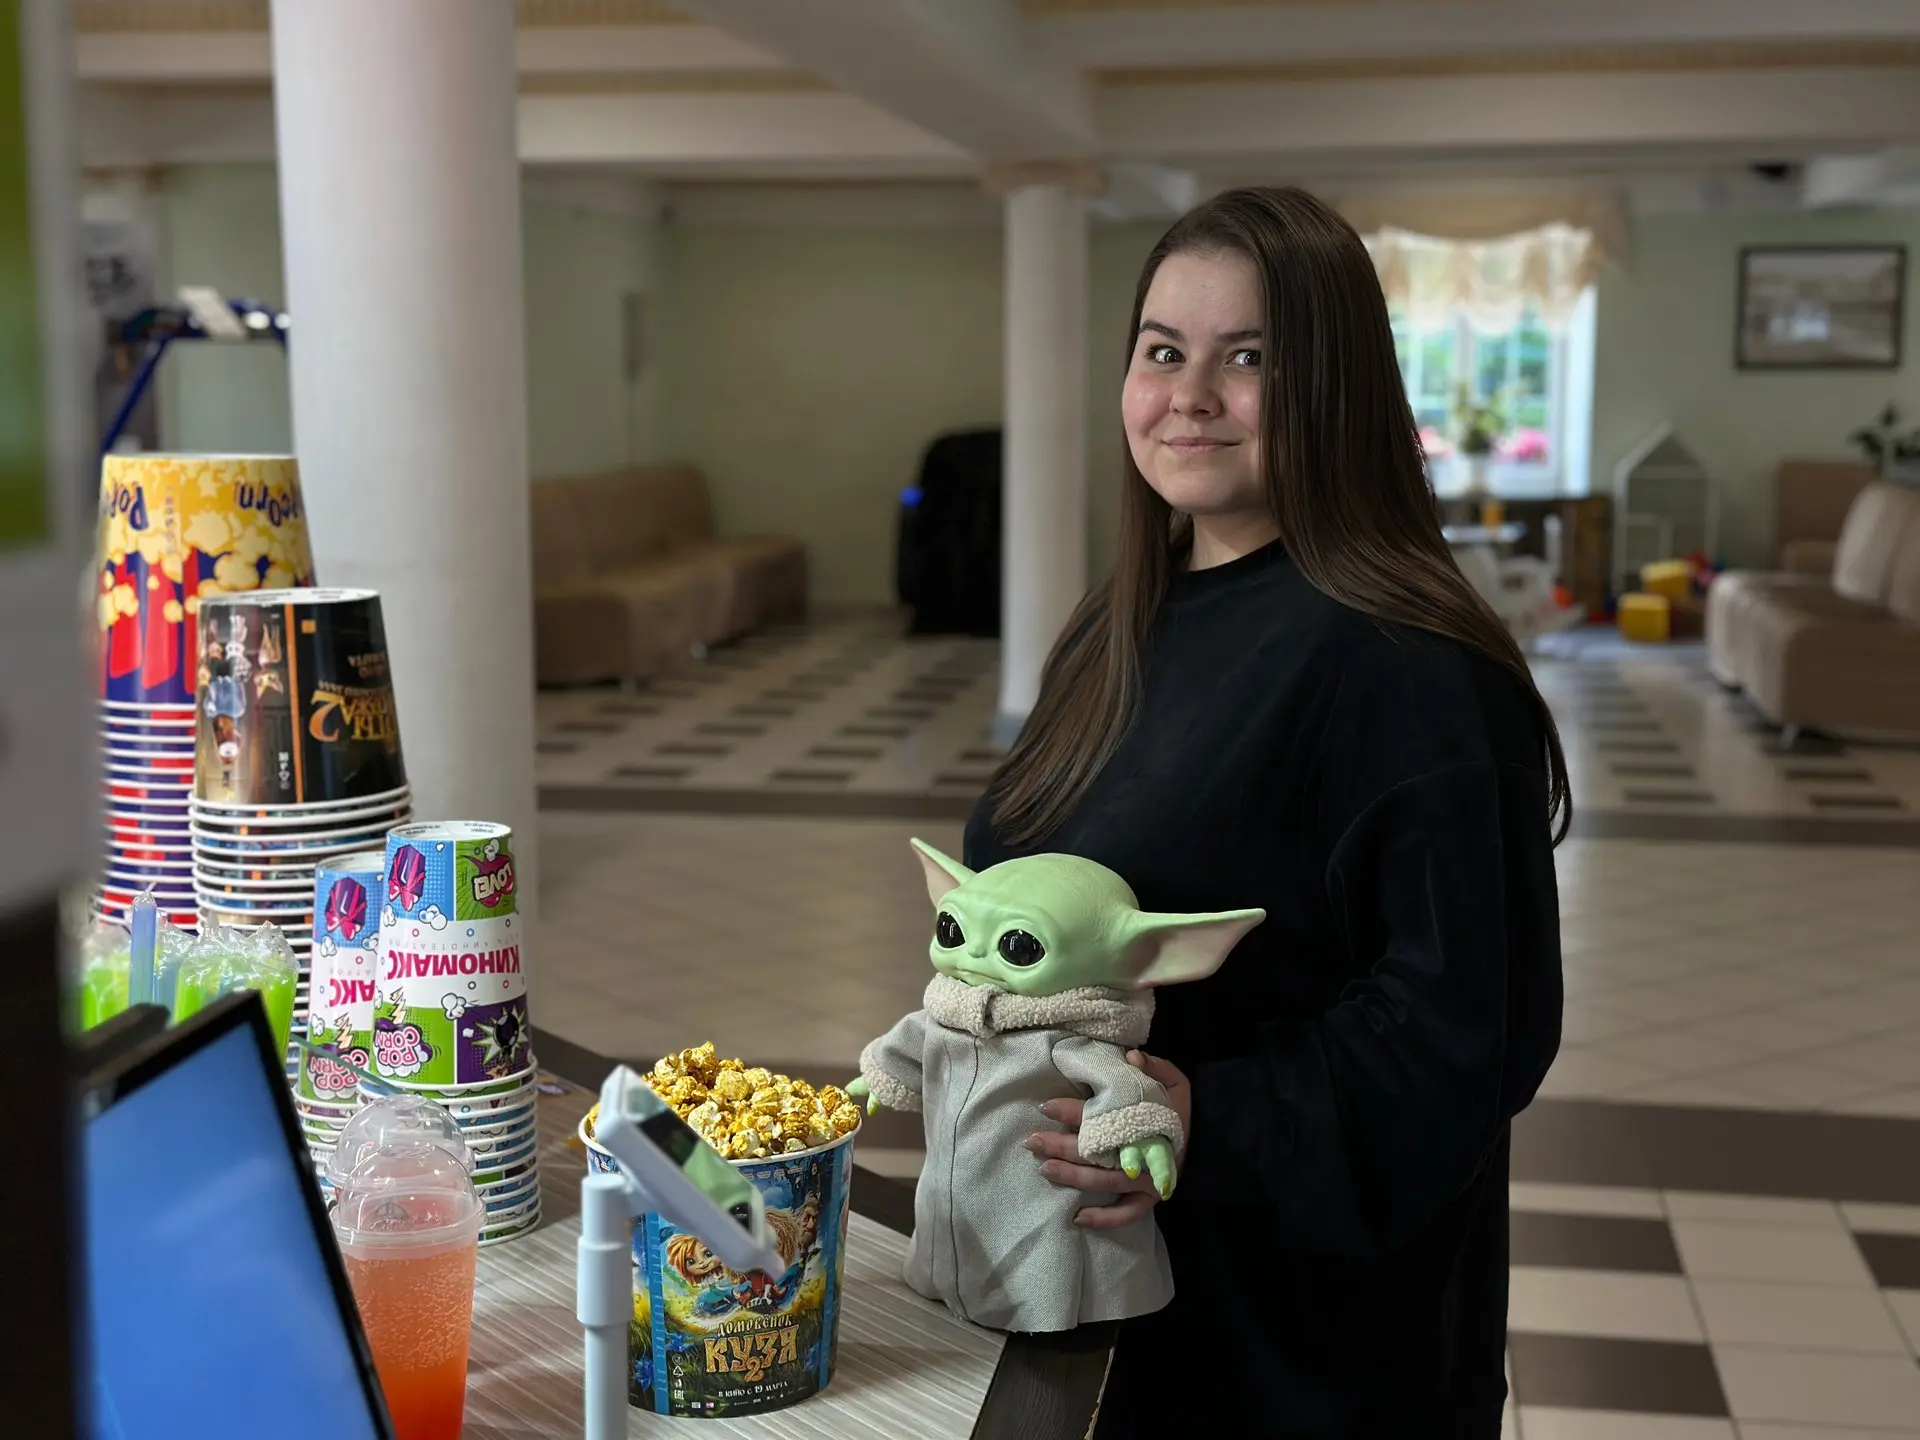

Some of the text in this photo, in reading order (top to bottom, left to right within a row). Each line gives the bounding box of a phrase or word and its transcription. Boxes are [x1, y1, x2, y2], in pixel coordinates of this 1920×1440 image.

[309, 690, 341, 742] 2
[473, 862, 513, 900] LOVE!
[386, 944, 521, 981] КИНОМАКС
[375, 1027, 420, 1050] CORN
[309, 1048, 368, 1074] CORN
[378, 1046, 417, 1067] POP
[315, 1071, 359, 1092] POP
[717, 1314, 793, 1337] ДОМОВЁНОК
[703, 1325, 800, 1373] КУЗЯ
[743, 1357, 765, 1383] 2
[725, 1389, 746, 1398] КИНО
[754, 1385, 763, 1394] 19
[765, 1381, 789, 1392] МАРТА
